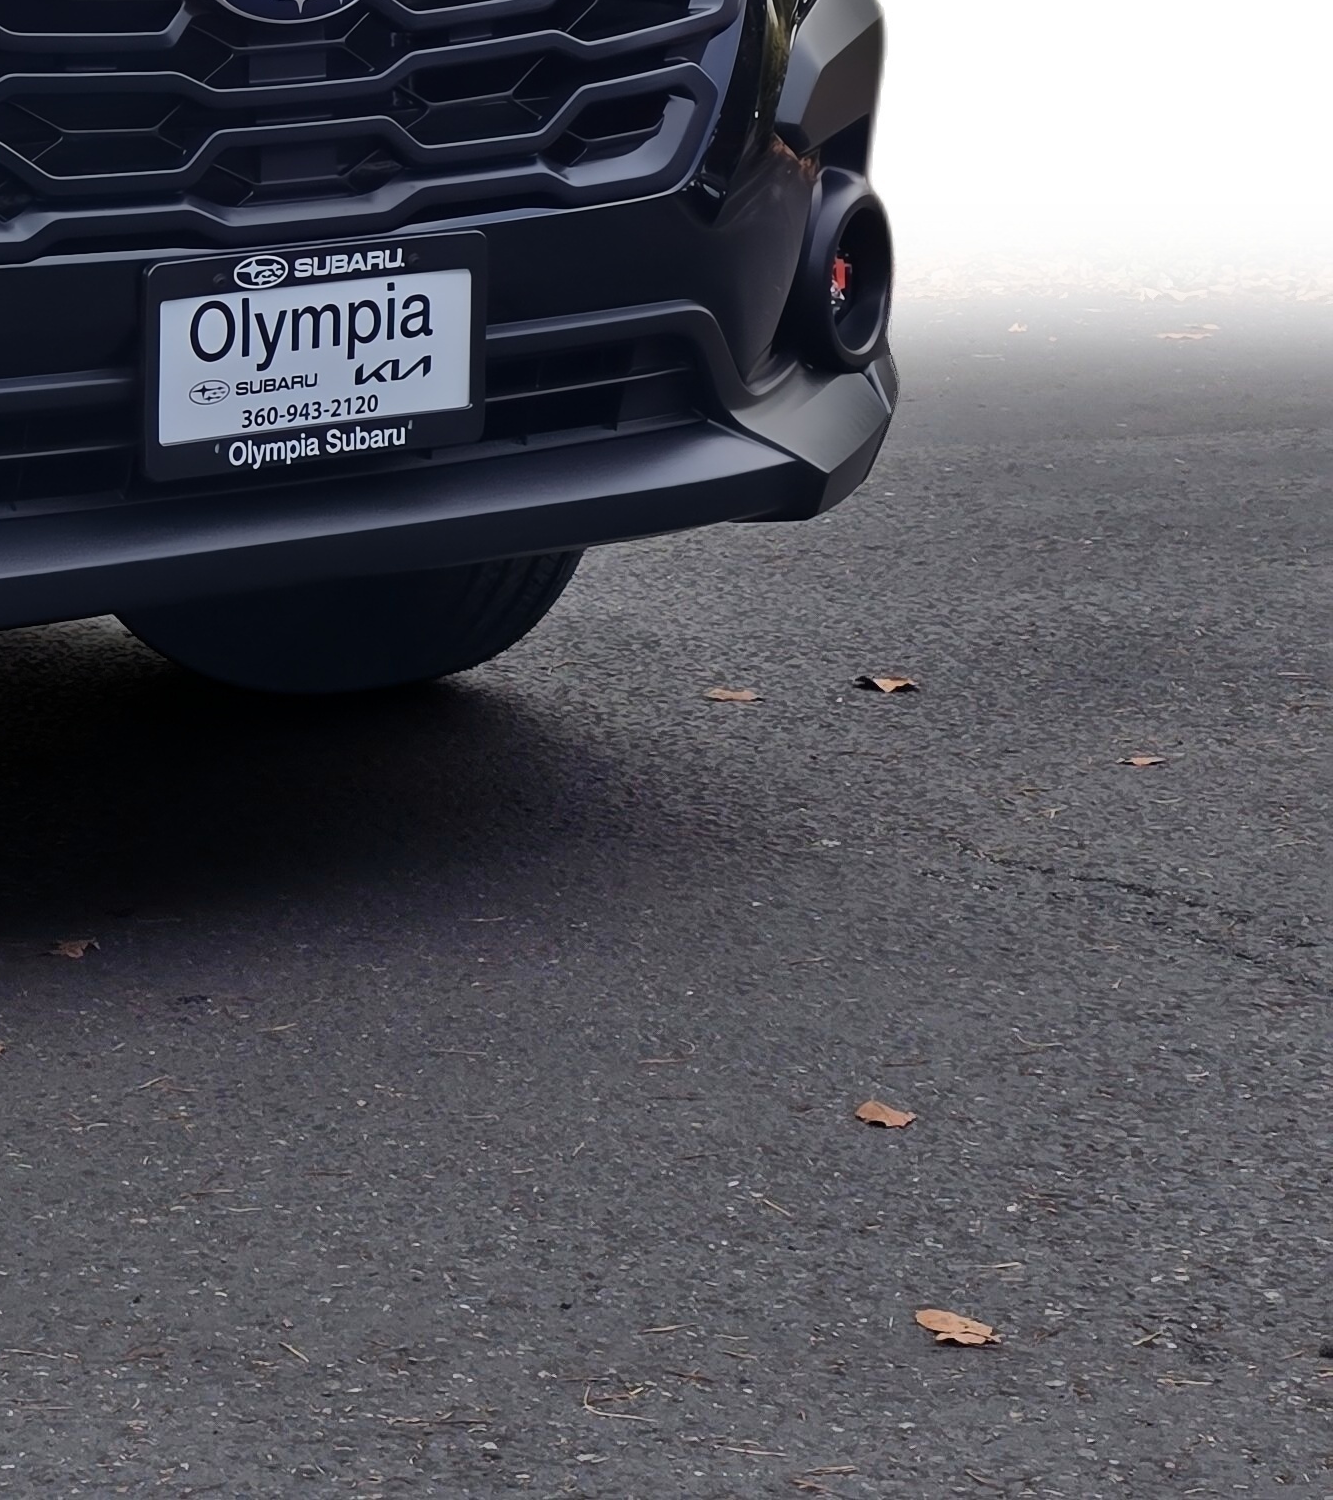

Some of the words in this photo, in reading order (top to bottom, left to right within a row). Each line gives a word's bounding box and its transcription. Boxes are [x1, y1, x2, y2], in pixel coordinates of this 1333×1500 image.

[189, 281, 434, 372] Olympia
[234, 372, 319, 396] SUBARU
[240, 393, 380, 429] 360-943-2120
[228, 432, 321, 470] Olympia
[325, 426, 407, 454] Subaru
